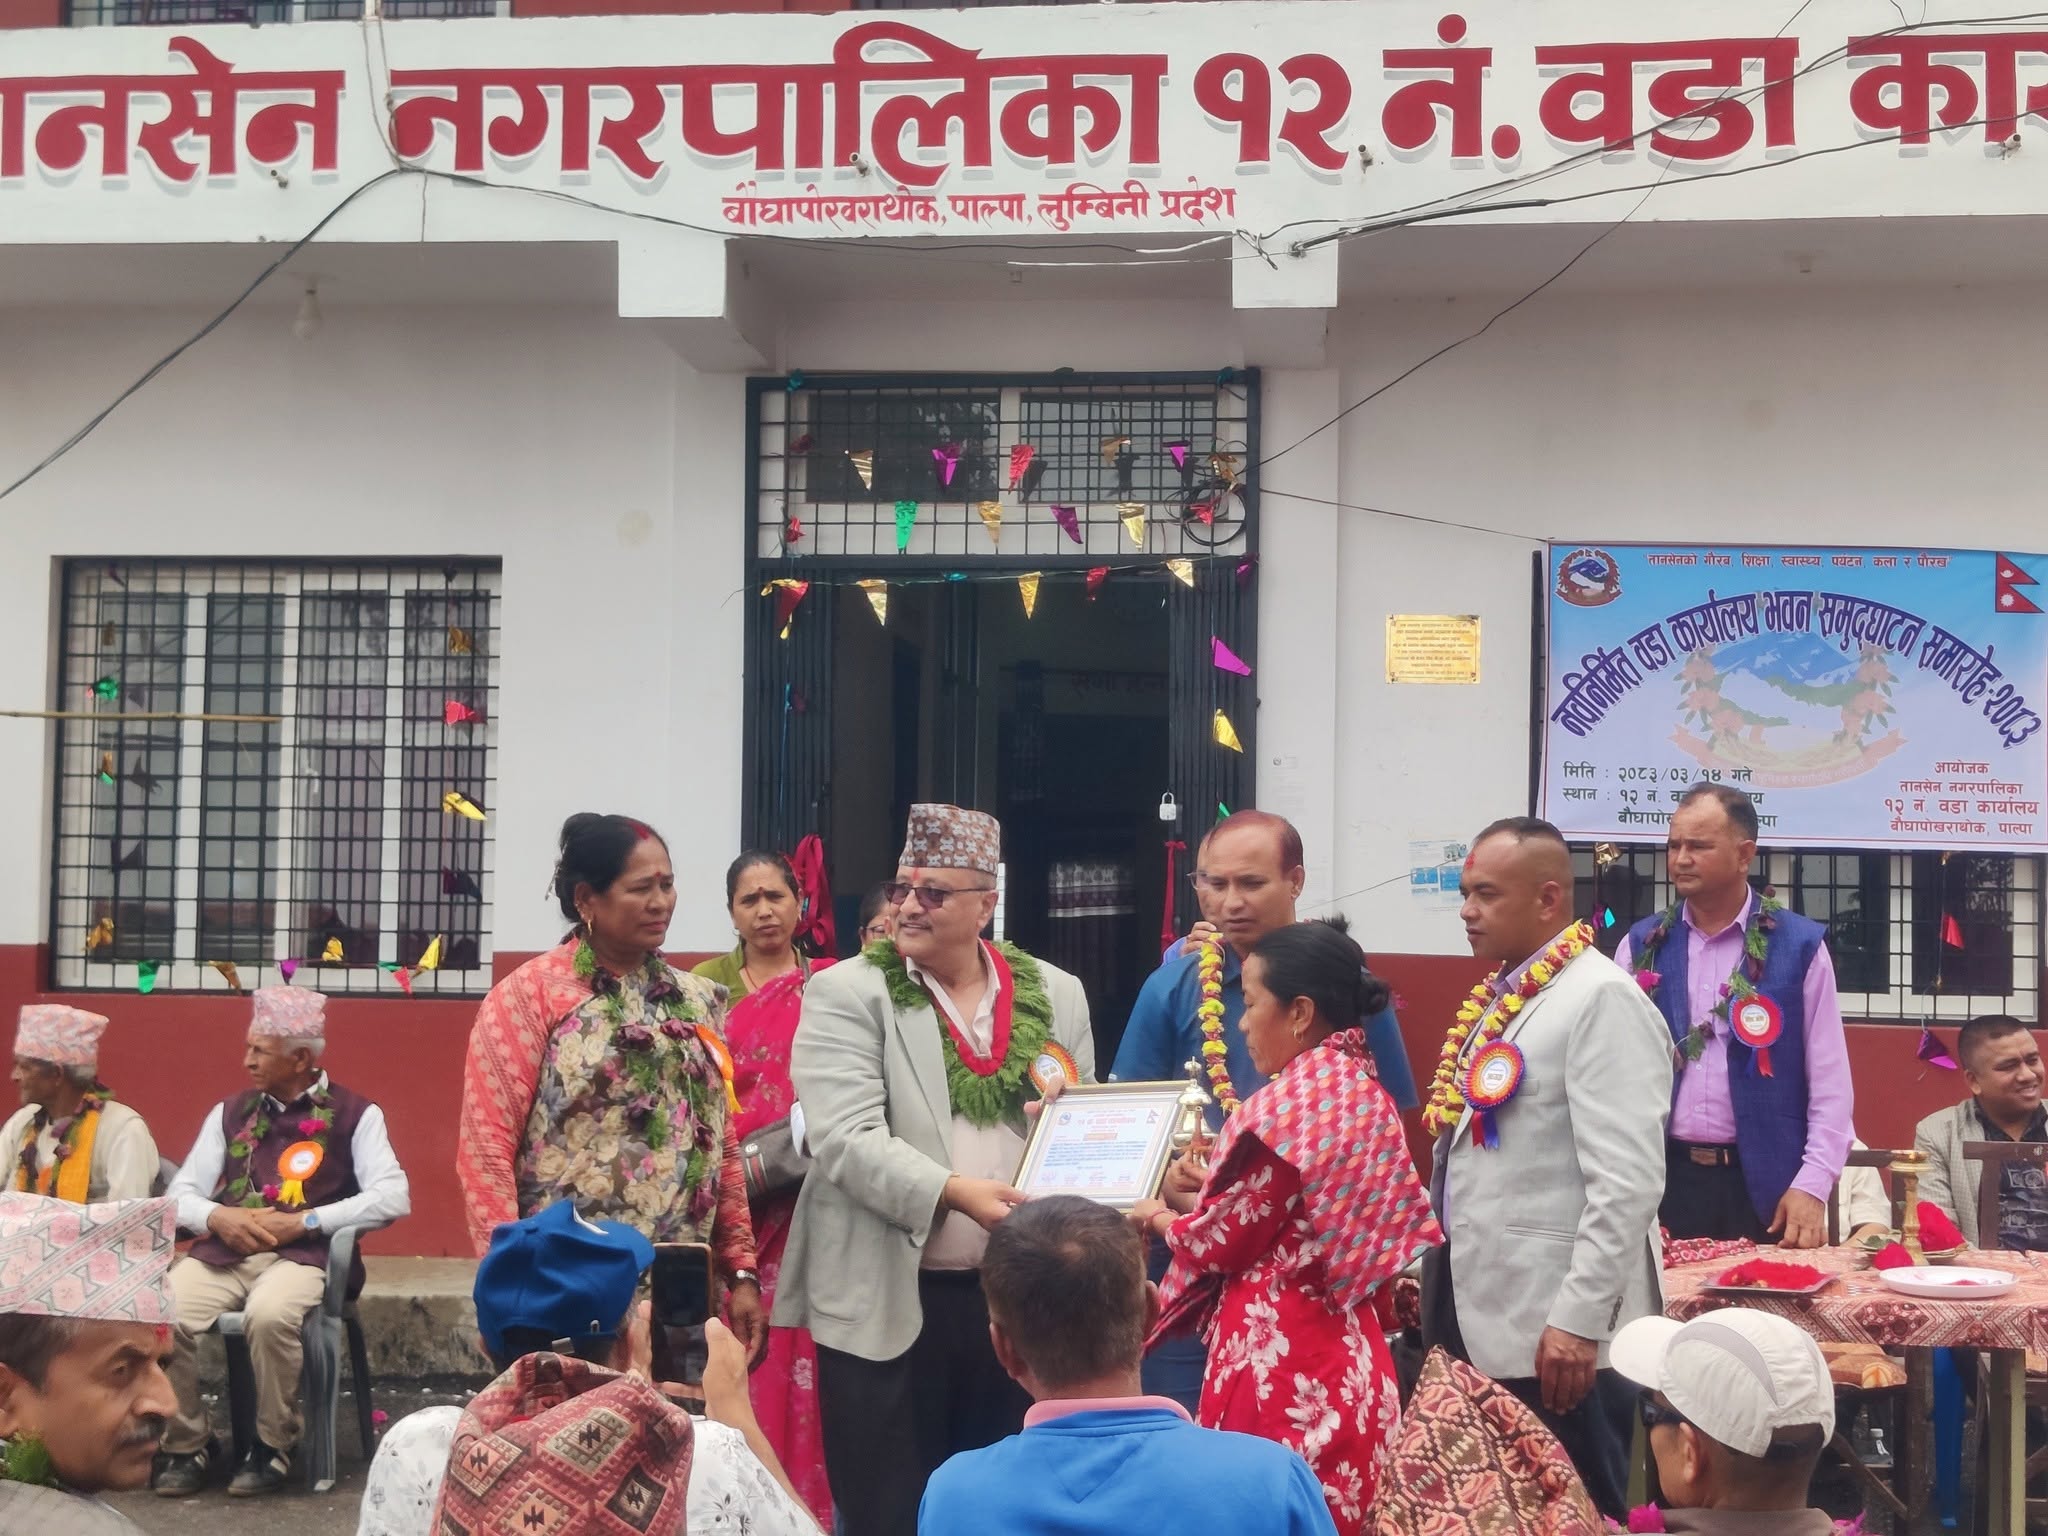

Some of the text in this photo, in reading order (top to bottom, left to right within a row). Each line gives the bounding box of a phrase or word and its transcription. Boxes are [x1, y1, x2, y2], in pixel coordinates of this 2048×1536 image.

[391, 21, 1168, 186] नगरपालिका
[1194, 52, 1352, 170] १२
[1382, 14, 1520, 160] नं.
[1535, 37, 1799, 161] वडा
[947, 193, 1033, 229] पाल्पा,
[1037, 179, 1150, 231] लुम्बिनी
[1158, 175, 1238, 227] प्रदेश
[1873, 556, 1897, 568] कला
[1903, 557, 1912, 568] र
[1550, 646, 1643, 737] नवनिर्मित
[1627, 622, 1676, 671] वडा
[1666, 589, 1759, 652] कार्यालय
[1763, 591, 1813, 632] भवन
[1563, 761, 1597, 779] मिति
[1618, 766, 1722, 784] २०८३/०३/१४
[1731, 766, 1753, 782] गते
[1934, 760, 1990, 774] आयोजक
[1900, 779, 2024, 795] तानसेन नगरपालिका
[1562, 788, 1598, 801] स्थान
[1619, 789, 1639, 805] १२
[1884, 798, 1905, 816] १२
[1939, 799, 1969, 815] वडा
[1976, 796, 2040, 816] कार्यालय
[1998, 822, 2033, 835] पाल्पा
